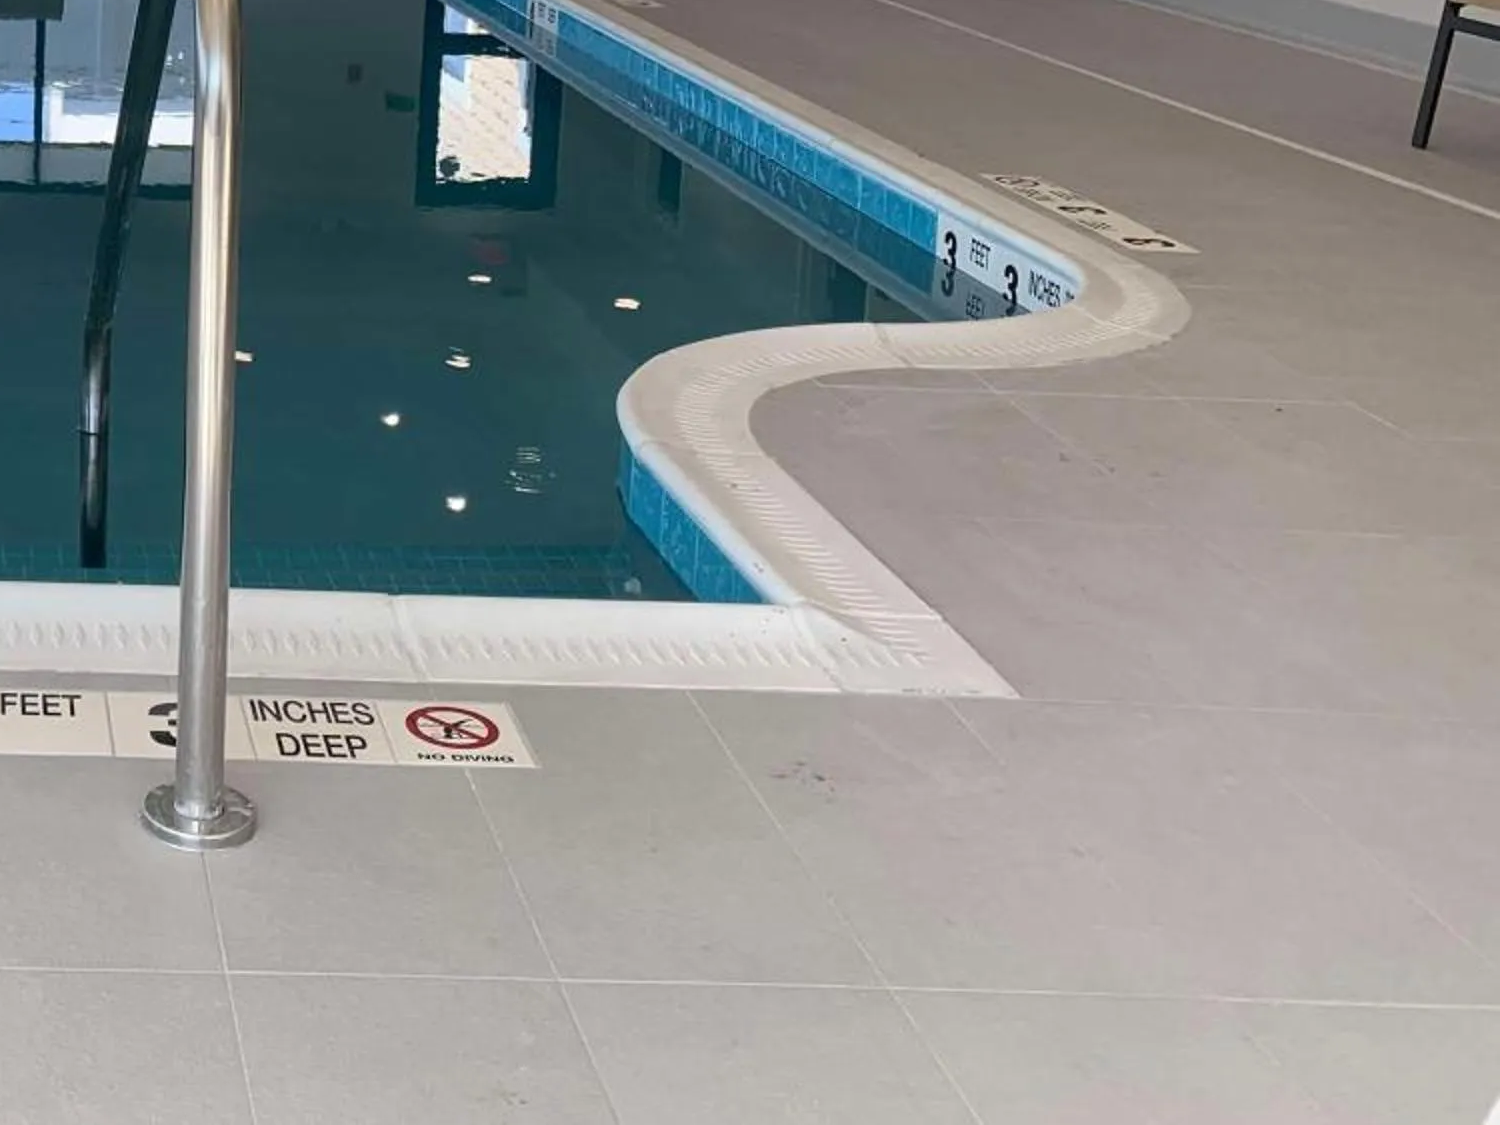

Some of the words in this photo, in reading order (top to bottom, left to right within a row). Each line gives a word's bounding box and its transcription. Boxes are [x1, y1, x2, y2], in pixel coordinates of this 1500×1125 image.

[944, 231, 957, 271] 3
[970, 237, 991, 271] FEET
[1002, 264, 1018, 306] 3
[0, 692, 82, 718] FEET
[249, 698, 376, 726] INCHES
[275, 732, 368, 759] DEEP
[417, 752, 446, 761] NO
[451, 754, 515, 763] DIVING
